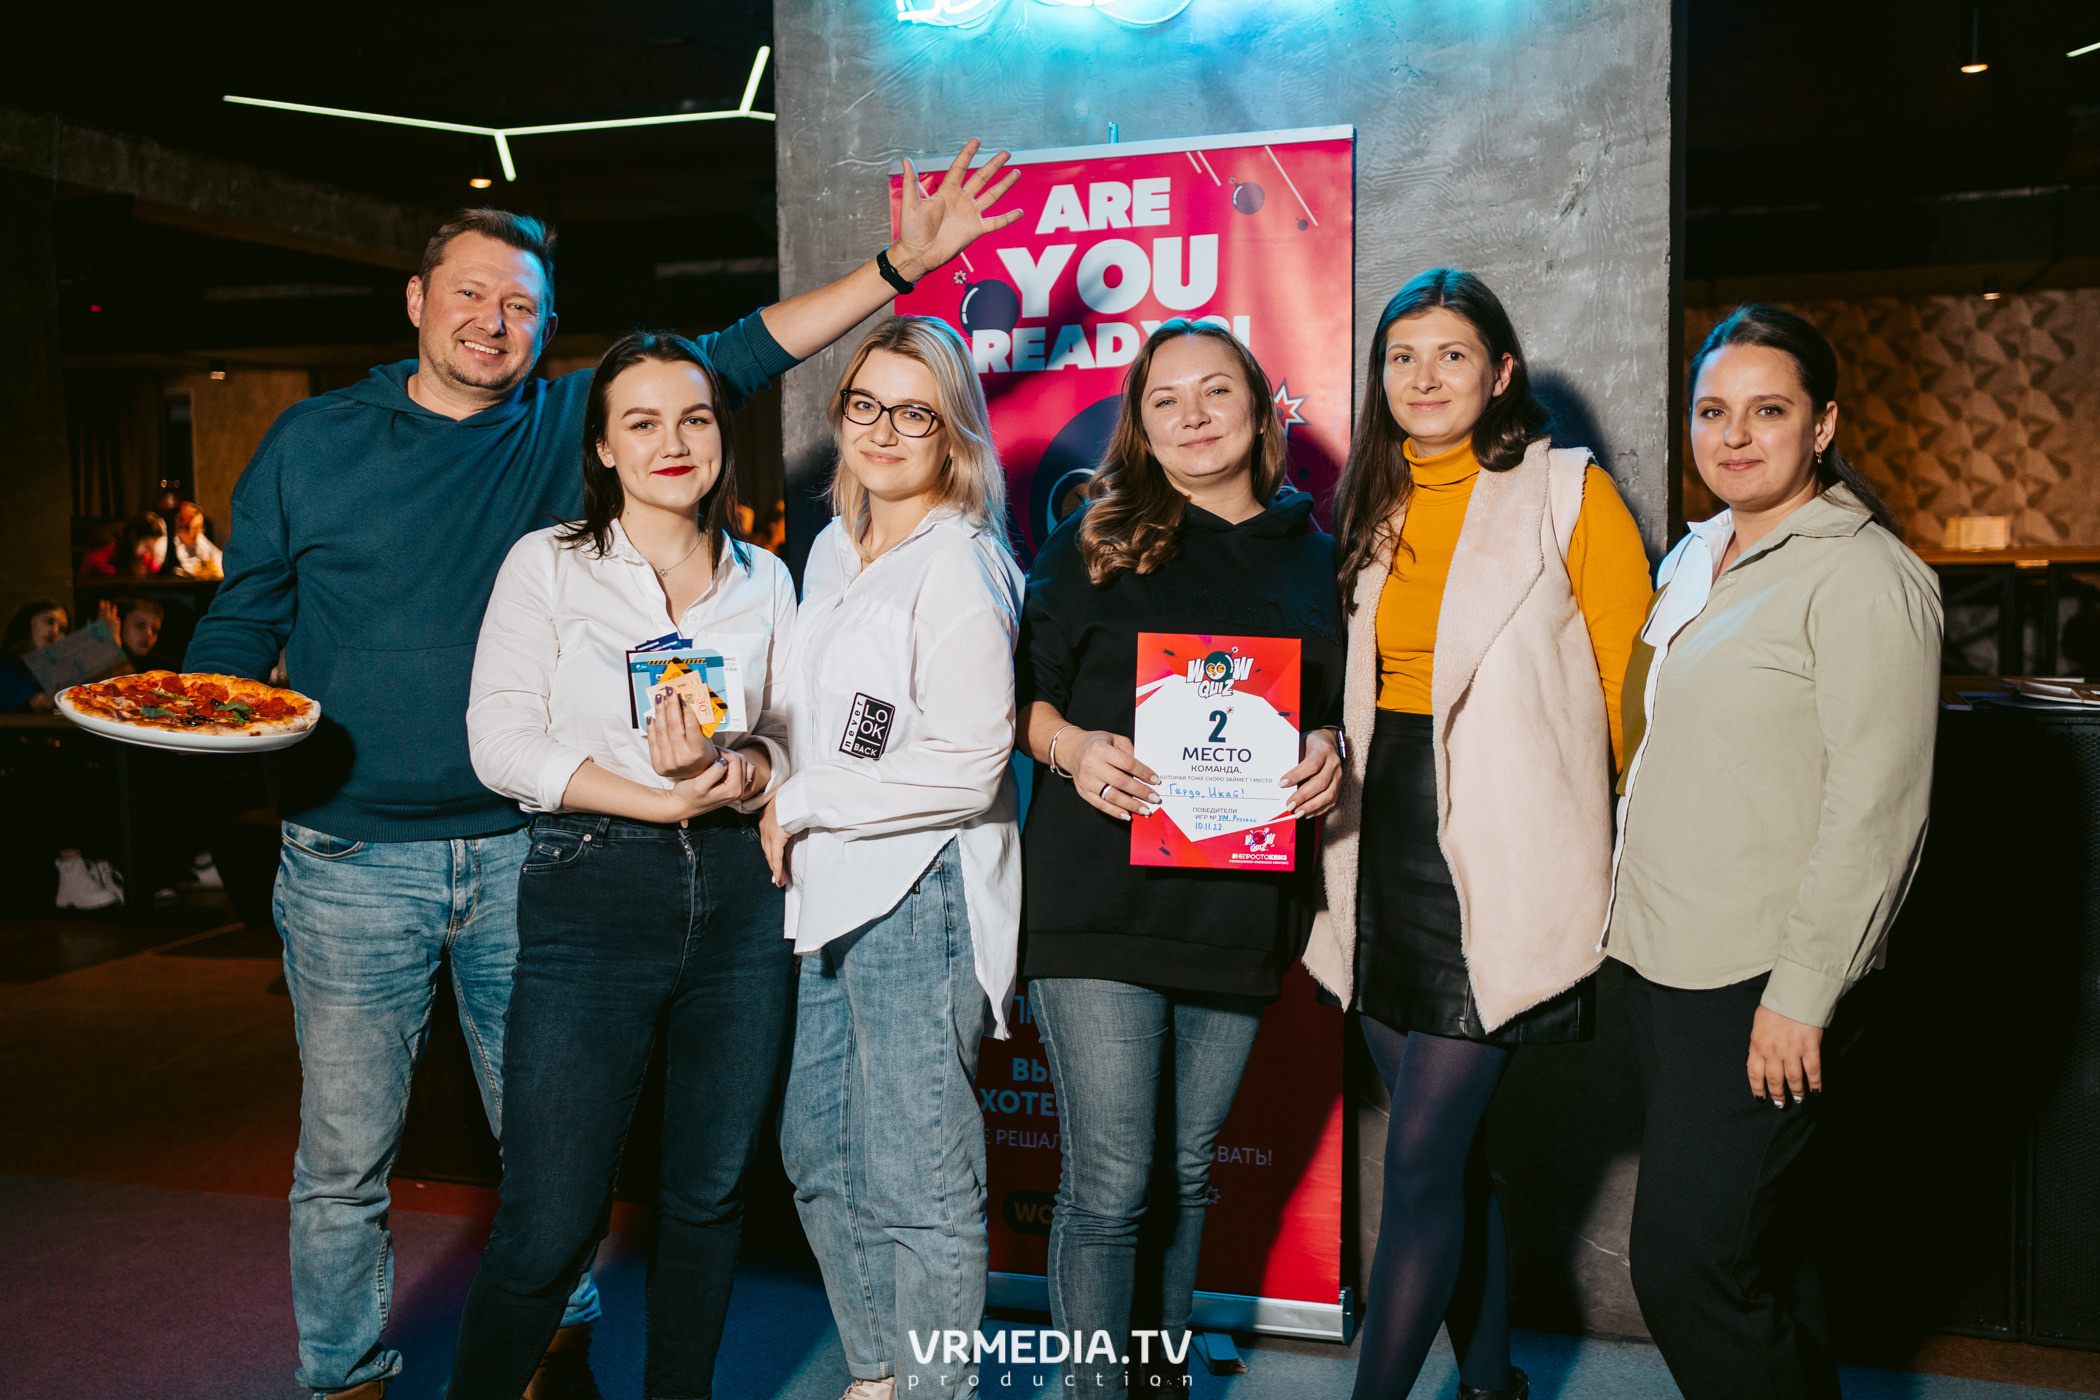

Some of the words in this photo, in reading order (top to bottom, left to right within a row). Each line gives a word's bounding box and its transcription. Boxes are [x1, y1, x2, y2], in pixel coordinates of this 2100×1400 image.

[1035, 177, 1172, 235] ARE
[996, 234, 1219, 319] YOU
[972, 315, 1250, 374] READ!
[1198, 680, 1235, 699] QUIZ
[845, 701, 863, 748] never
[1208, 710, 1228, 743] 2
[854, 743, 878, 756] BACK
[1182, 747, 1252, 763] МЕСТО
[1191, 764, 1242, 775] КОМАНДА,
[979, 1088, 1060, 1117] ХОТЕ
[1217, 1145, 1273, 1167] ВАТЬ!
